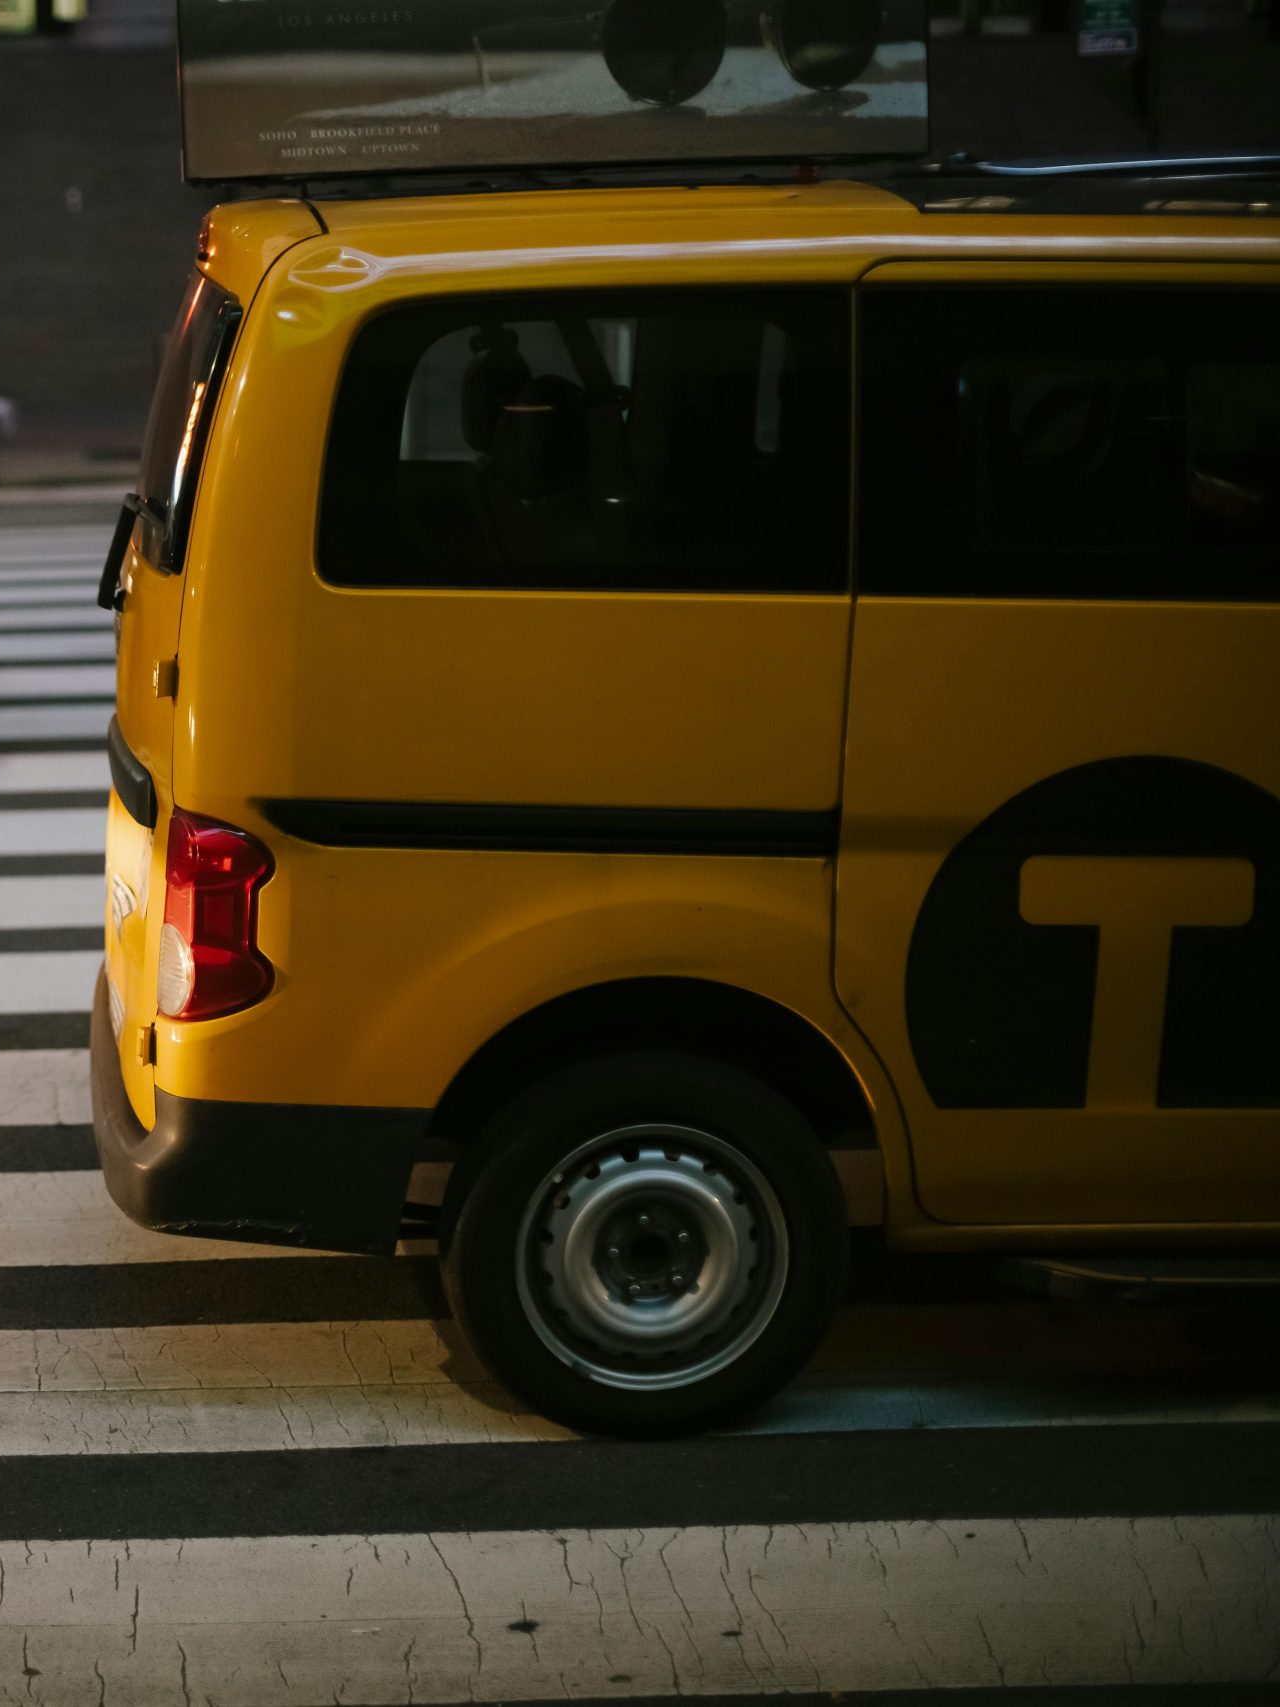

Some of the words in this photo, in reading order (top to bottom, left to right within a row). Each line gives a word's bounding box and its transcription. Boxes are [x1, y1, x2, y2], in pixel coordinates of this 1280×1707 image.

[277, 15, 313, 27] LOS
[325, 10, 414, 25] ANGELES
[258, 130, 298, 142] SOHO
[310, 126, 395, 139] BROOKFIELD
[399, 123, 441, 136] PLACE
[281, 144, 347, 158] MIDTOWN
[361, 142, 420, 155] UPTOWN
[1019, 855, 1255, 1112] T
